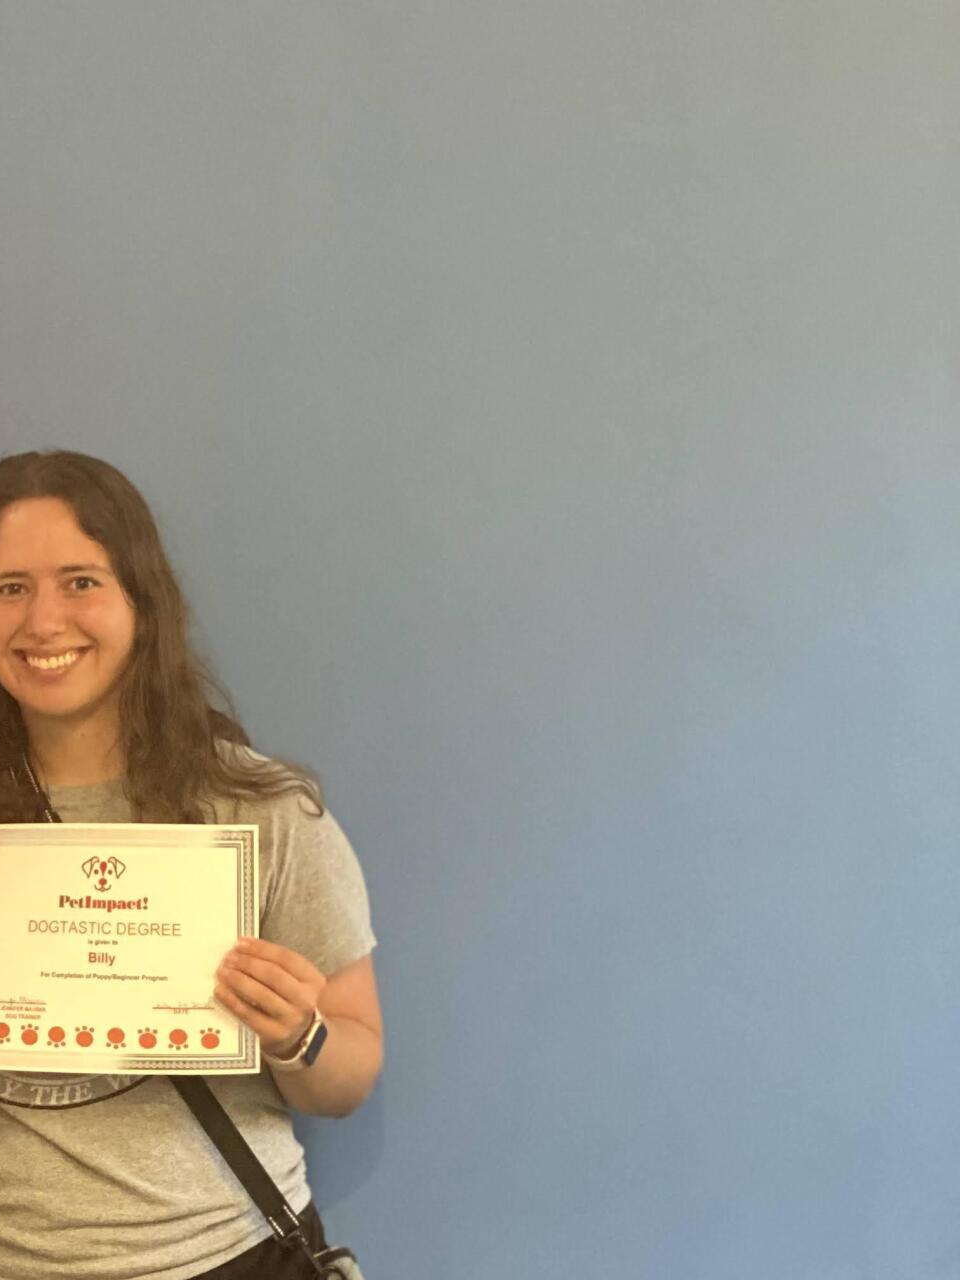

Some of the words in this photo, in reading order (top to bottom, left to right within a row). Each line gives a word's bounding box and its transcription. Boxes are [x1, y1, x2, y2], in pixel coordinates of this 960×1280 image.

[58, 895, 149, 913] PetImpact!
[28, 920, 112, 935] DOGTASTIC
[116, 922, 182, 936] DEGREE
[88, 952, 116, 966] Billy
[30, 1081, 92, 1105] THE
